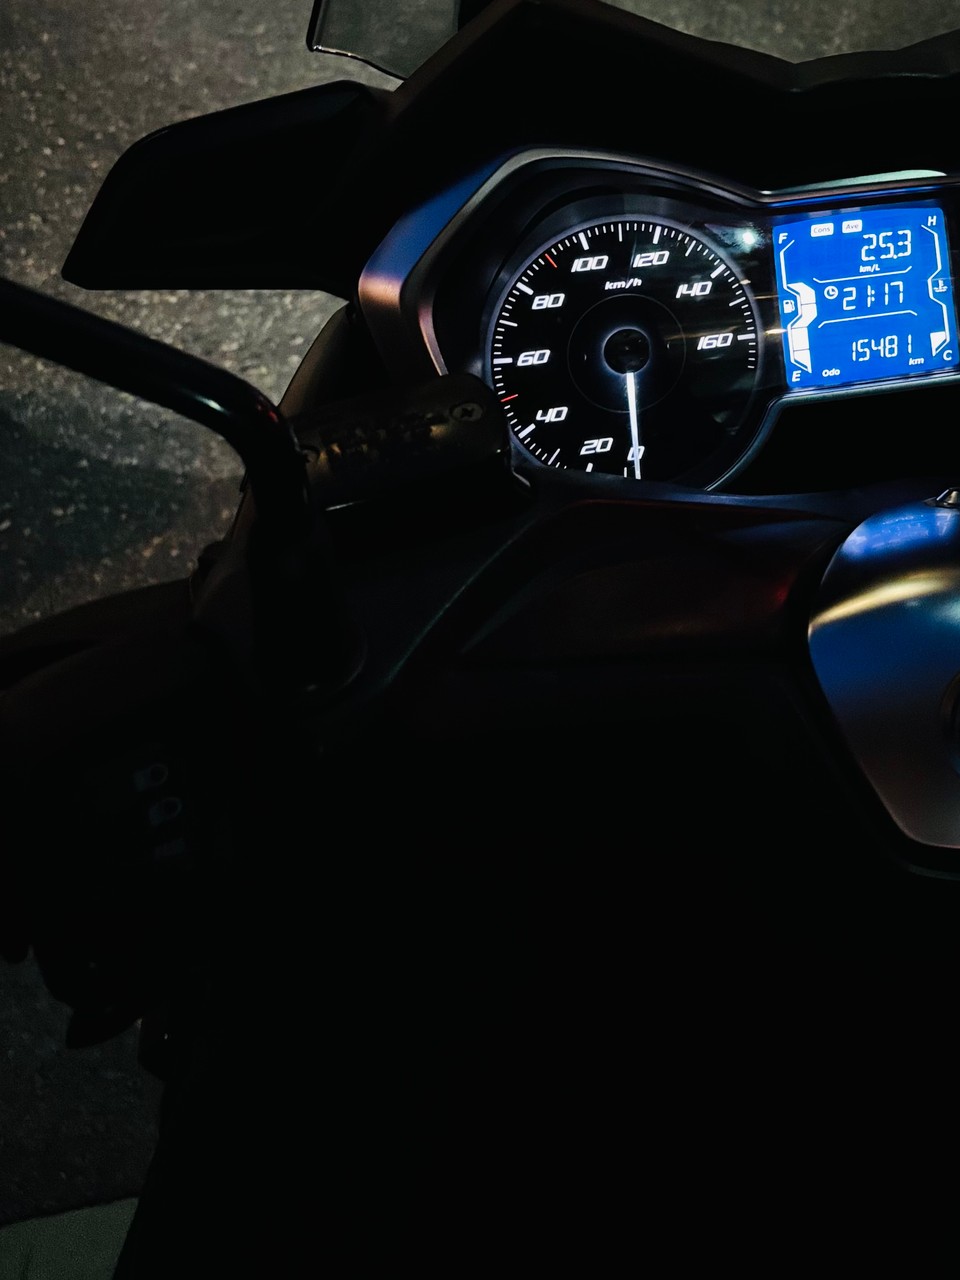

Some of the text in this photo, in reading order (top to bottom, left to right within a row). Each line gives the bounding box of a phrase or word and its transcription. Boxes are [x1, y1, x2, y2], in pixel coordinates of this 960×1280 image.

[927, 215, 937, 227] H
[778, 232, 788, 244] F
[860, 229, 912, 261] 25.3
[570, 255, 609, 273] 100
[632, 250, 670, 268] 120
[859, 263, 881, 273] km/L
[604, 277, 642, 290] km/h
[675, 280, 713, 299] 140
[531, 293, 566, 310] 80
[842, 281, 904, 311] 21:17
[696, 332, 734, 351] 160
[852, 334, 925, 366] 15481 km
[516, 349, 551, 367] 60
[942, 349, 953, 361] C
[791, 370, 802, 383] E
[821, 368, 841, 378] Odo
[535, 406, 569, 423] 40
[579, 437, 614, 456] 20
[627, 445, 645, 461] 0
